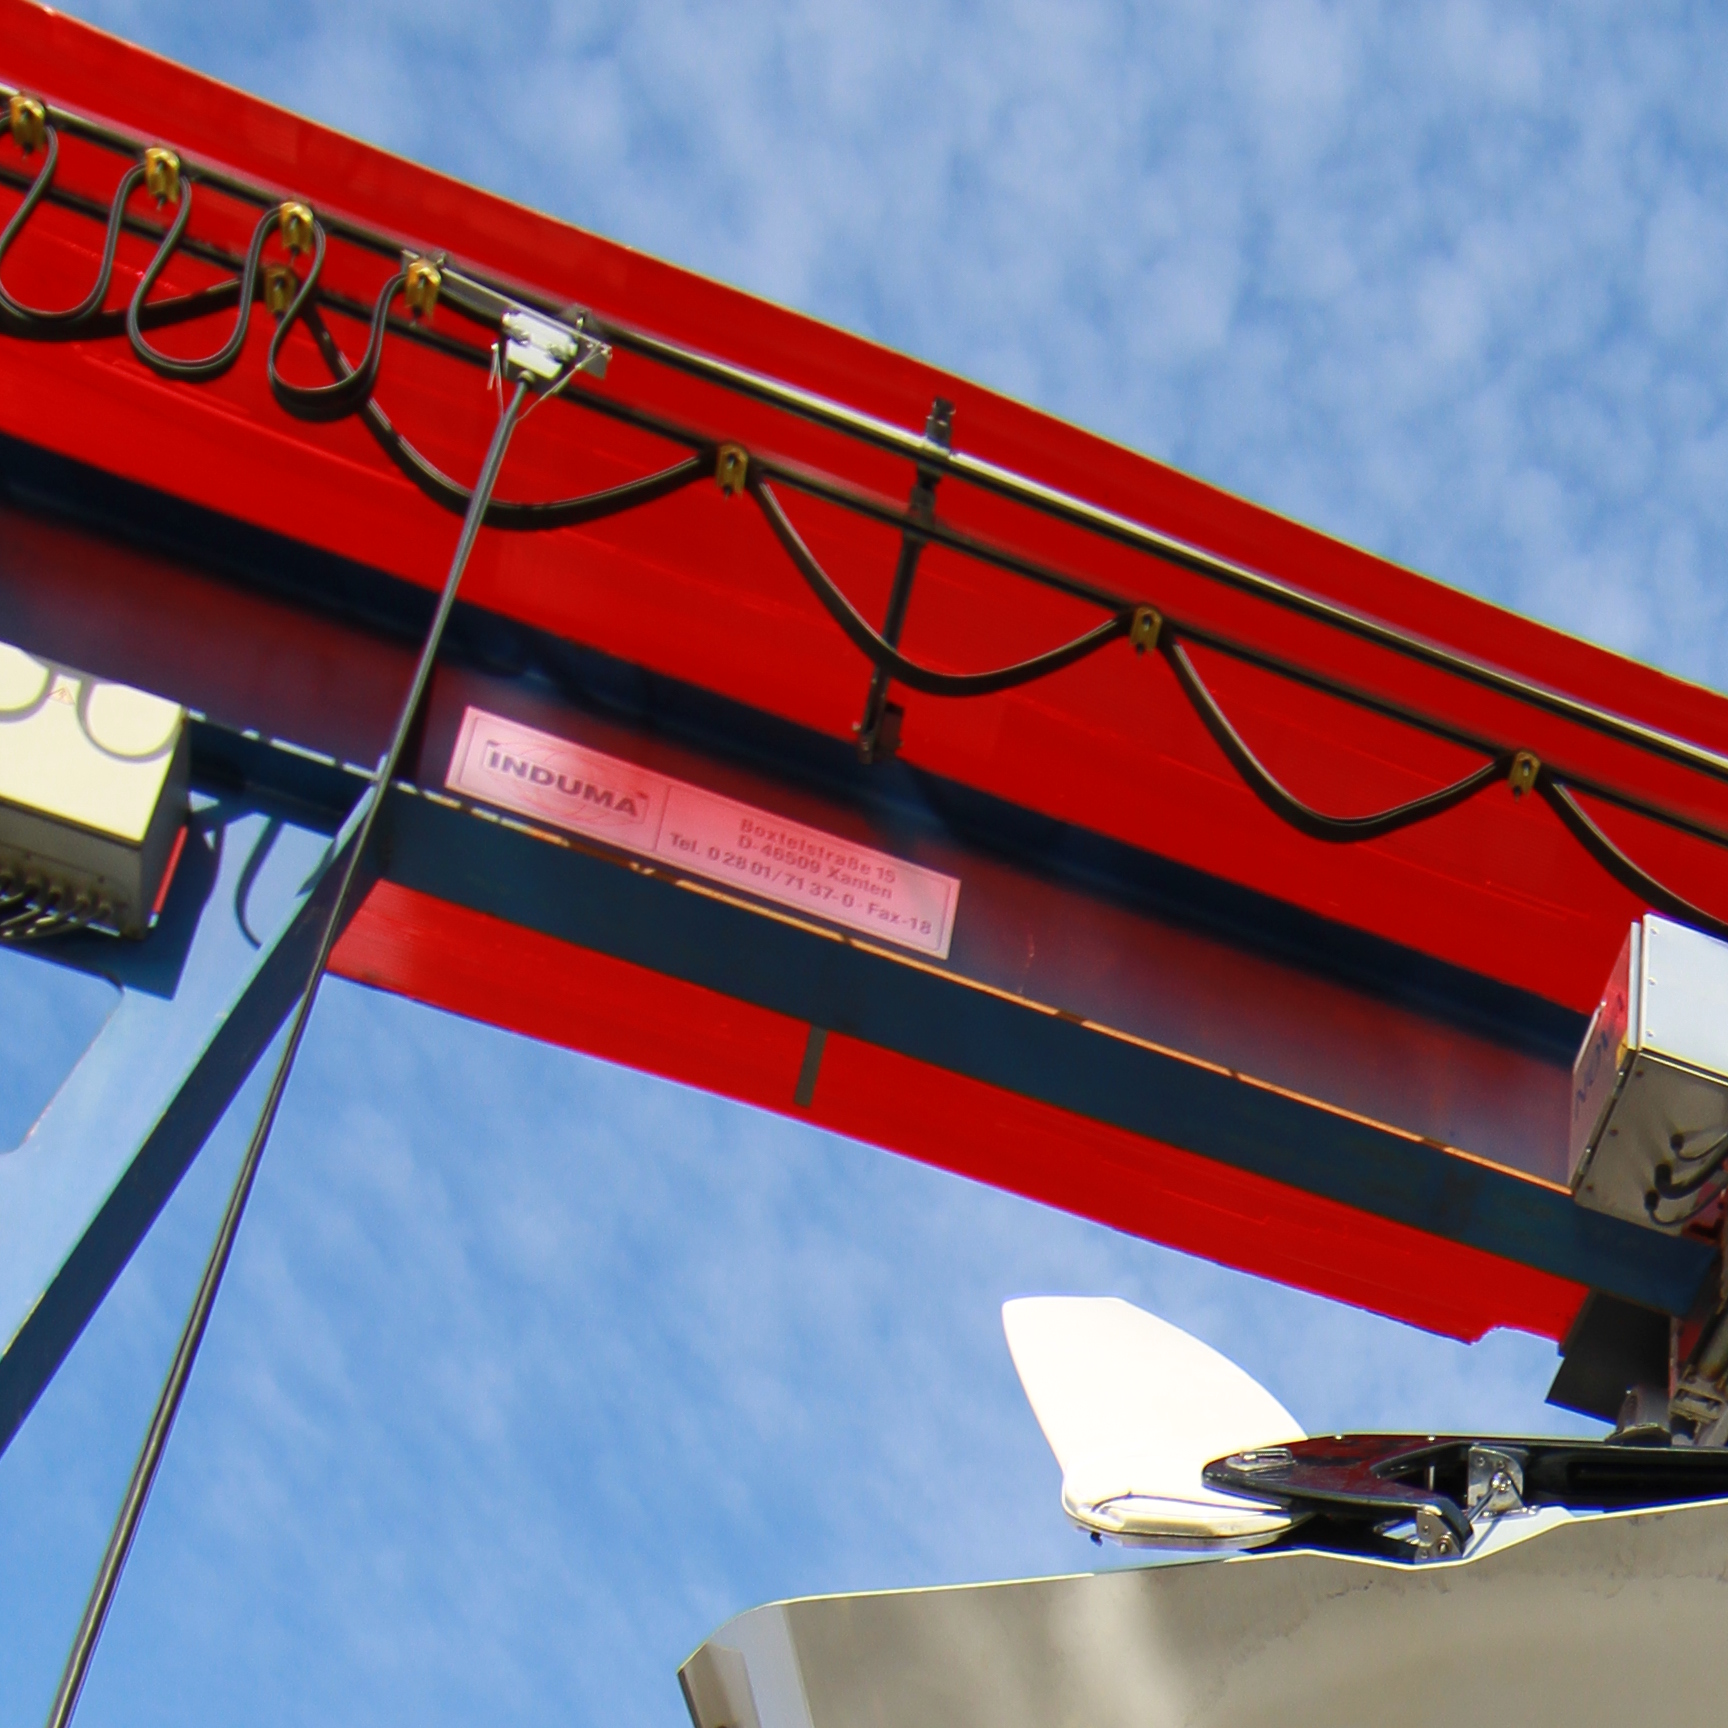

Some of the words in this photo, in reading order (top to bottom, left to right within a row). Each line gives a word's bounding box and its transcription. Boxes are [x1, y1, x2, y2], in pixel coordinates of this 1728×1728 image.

[487, 750, 638, 818] INDUMA
[670, 832, 699, 856] Tel.
[740, 818, 872, 876] Boxtelstraße
[876, 866, 896, 884] 15
[826, 866, 894, 900] Xanten
